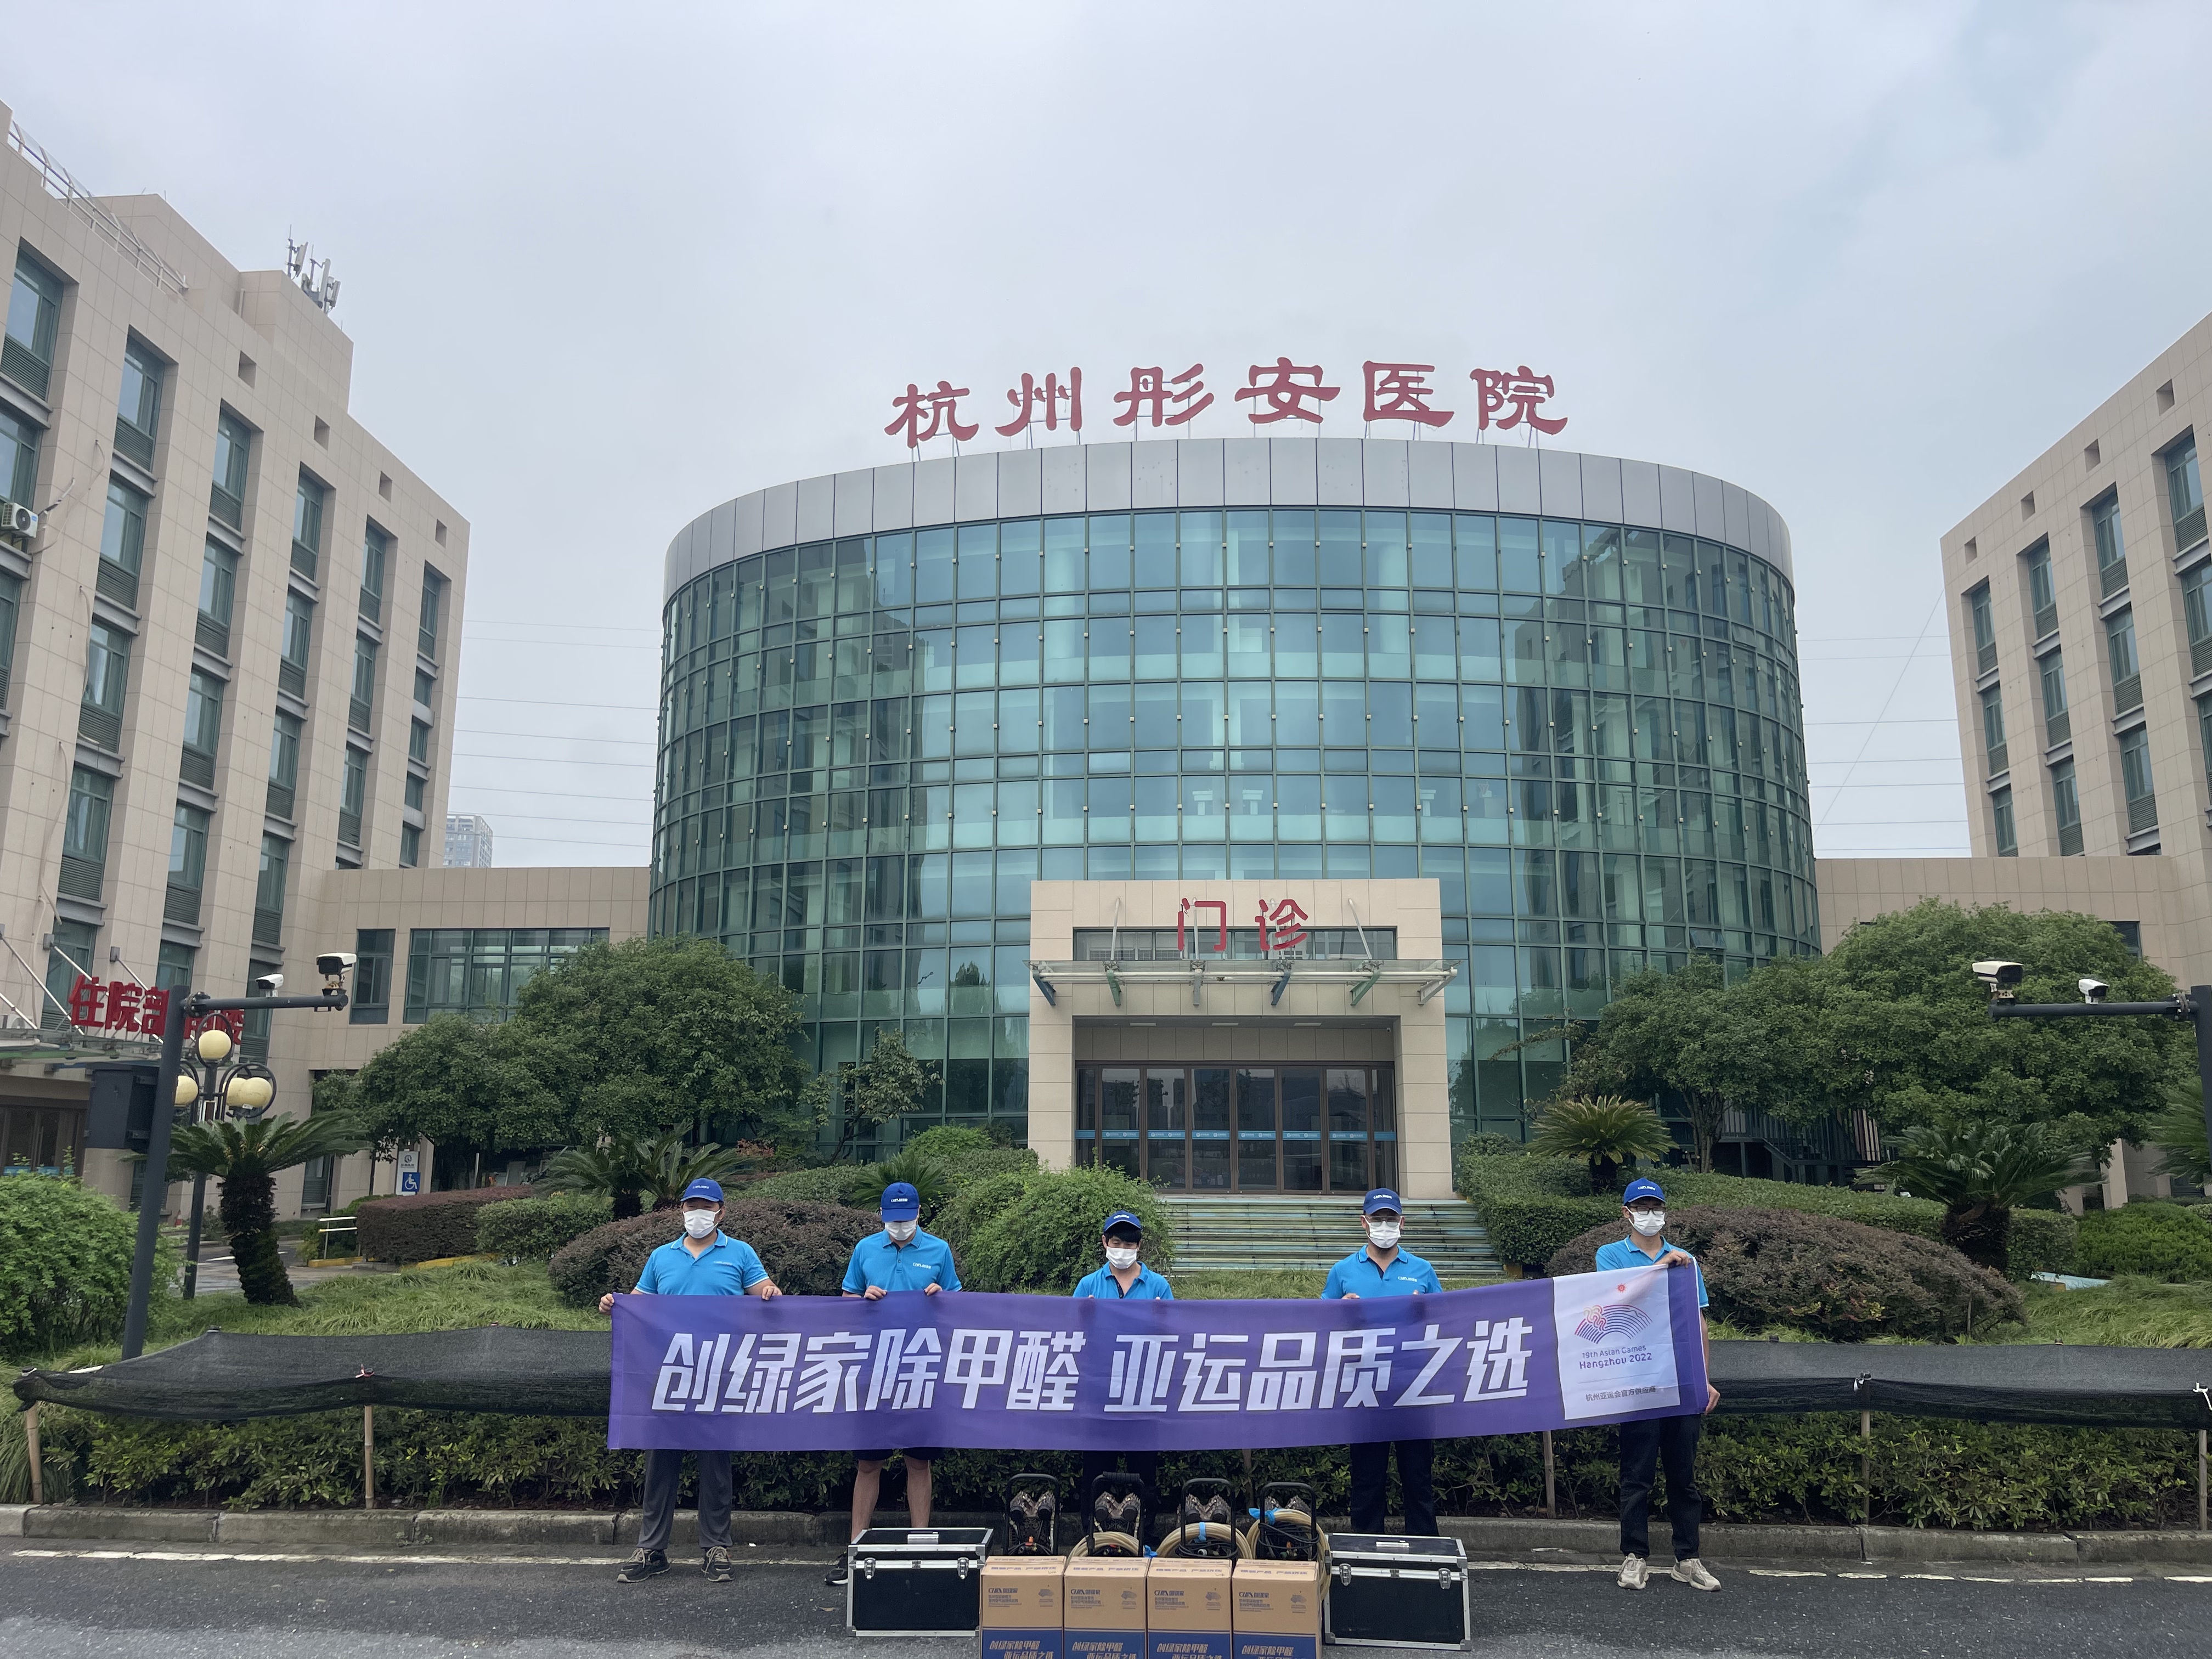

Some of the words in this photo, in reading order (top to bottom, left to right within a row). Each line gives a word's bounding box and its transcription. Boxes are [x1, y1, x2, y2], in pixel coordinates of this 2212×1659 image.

[885, 357, 1567, 447] 杭州彤安医院
[1177, 898, 1308, 951] 门诊
[652, 1328, 1086, 1414] 创绿家除甲醛
[1104, 1317, 1533, 1413] 亚运品质之选
[1579, 1357, 1627, 1369] Hangzhou
[1629, 1352, 1652, 1363] 2022
[1599, 1349, 1620, 1357] Asian
[1621, 1345, 1646, 1354] Games
[1585, 1385, 1656, 1402] 杭州亚运会官方供应商
